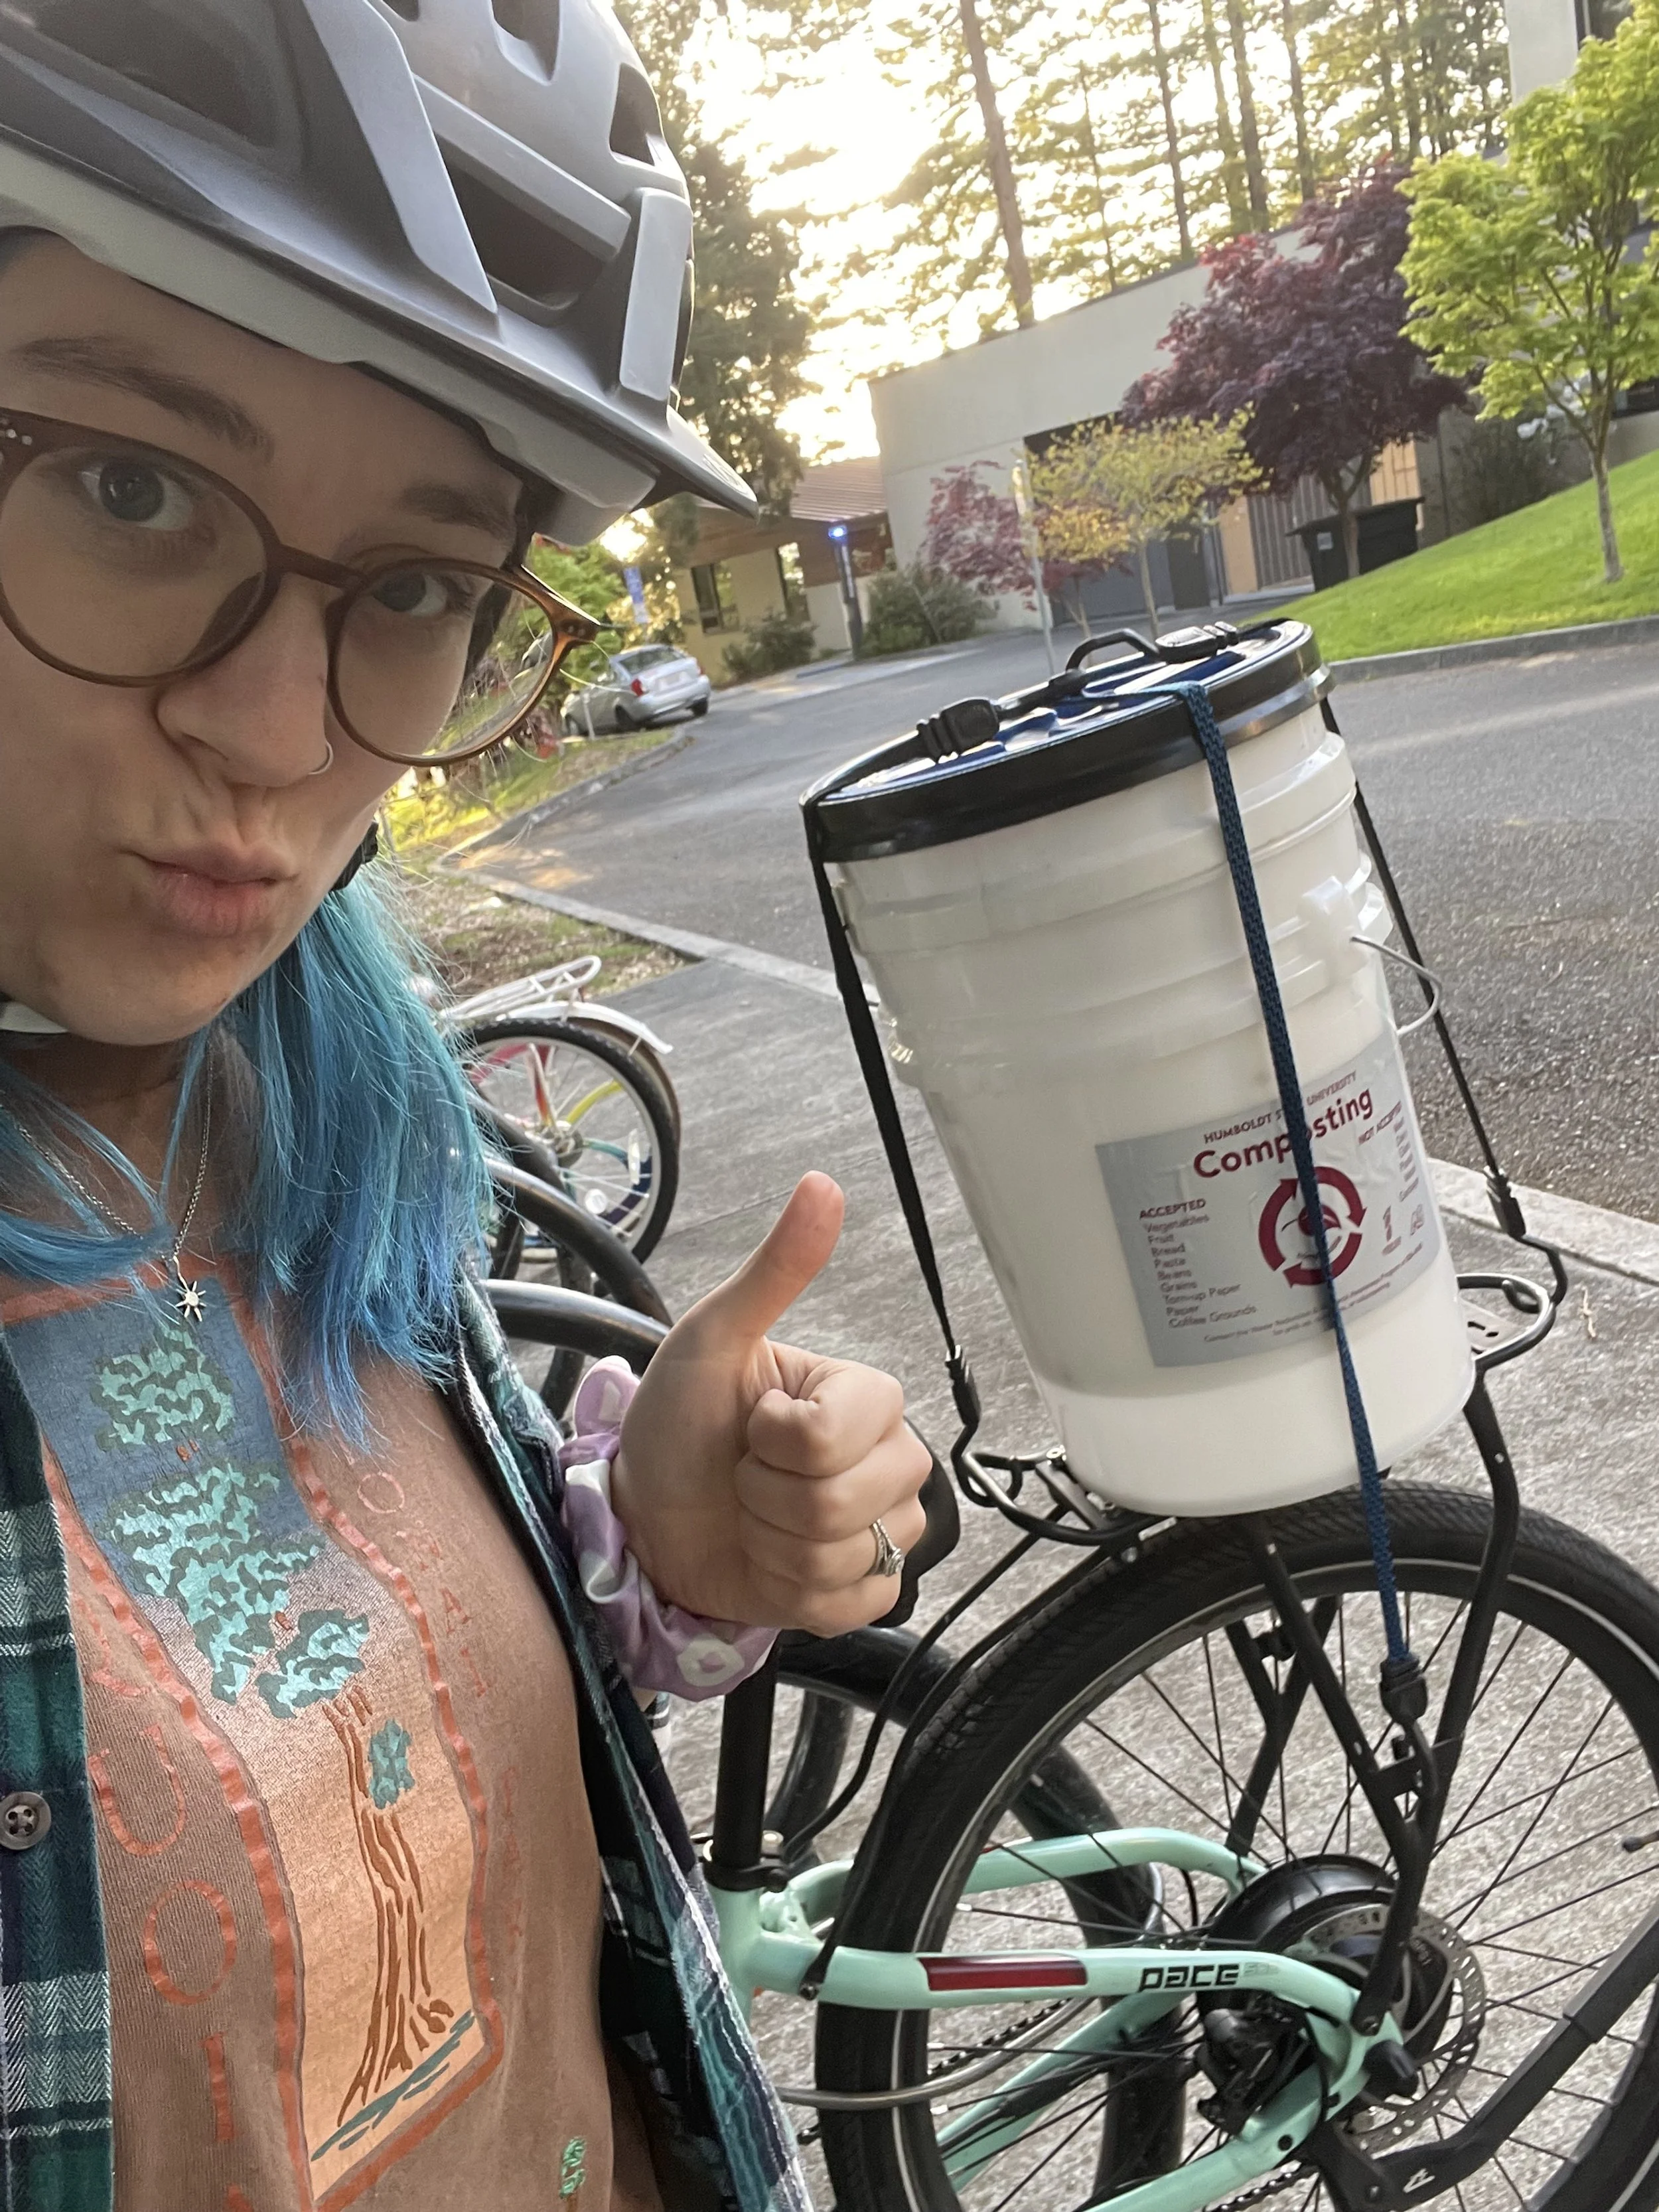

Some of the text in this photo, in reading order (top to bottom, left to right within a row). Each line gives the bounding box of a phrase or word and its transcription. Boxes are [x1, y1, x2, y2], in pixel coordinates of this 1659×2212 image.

[1204, 1070, 1357, 1144] HUMBOLDT UNIVERSITY
[1193, 1088, 1373, 1179] Compsting
[1139, 1198, 1207, 1220] ACCEPTED
[1143, 1213, 1210, 1232] Vegetables
[1147, 1233, 1174, 1244] Fruit
[1151, 1242, 1186, 1258] Bread
[1153, 1258, 1187, 1269] Pasta
[1160, 1280, 1198, 1293] Grains
[1208, 1284, 1242, 1299] Paper
[1168, 1315, 1207, 1329] Coffee
[1209, 1304, 1258, 1323] Grounds
